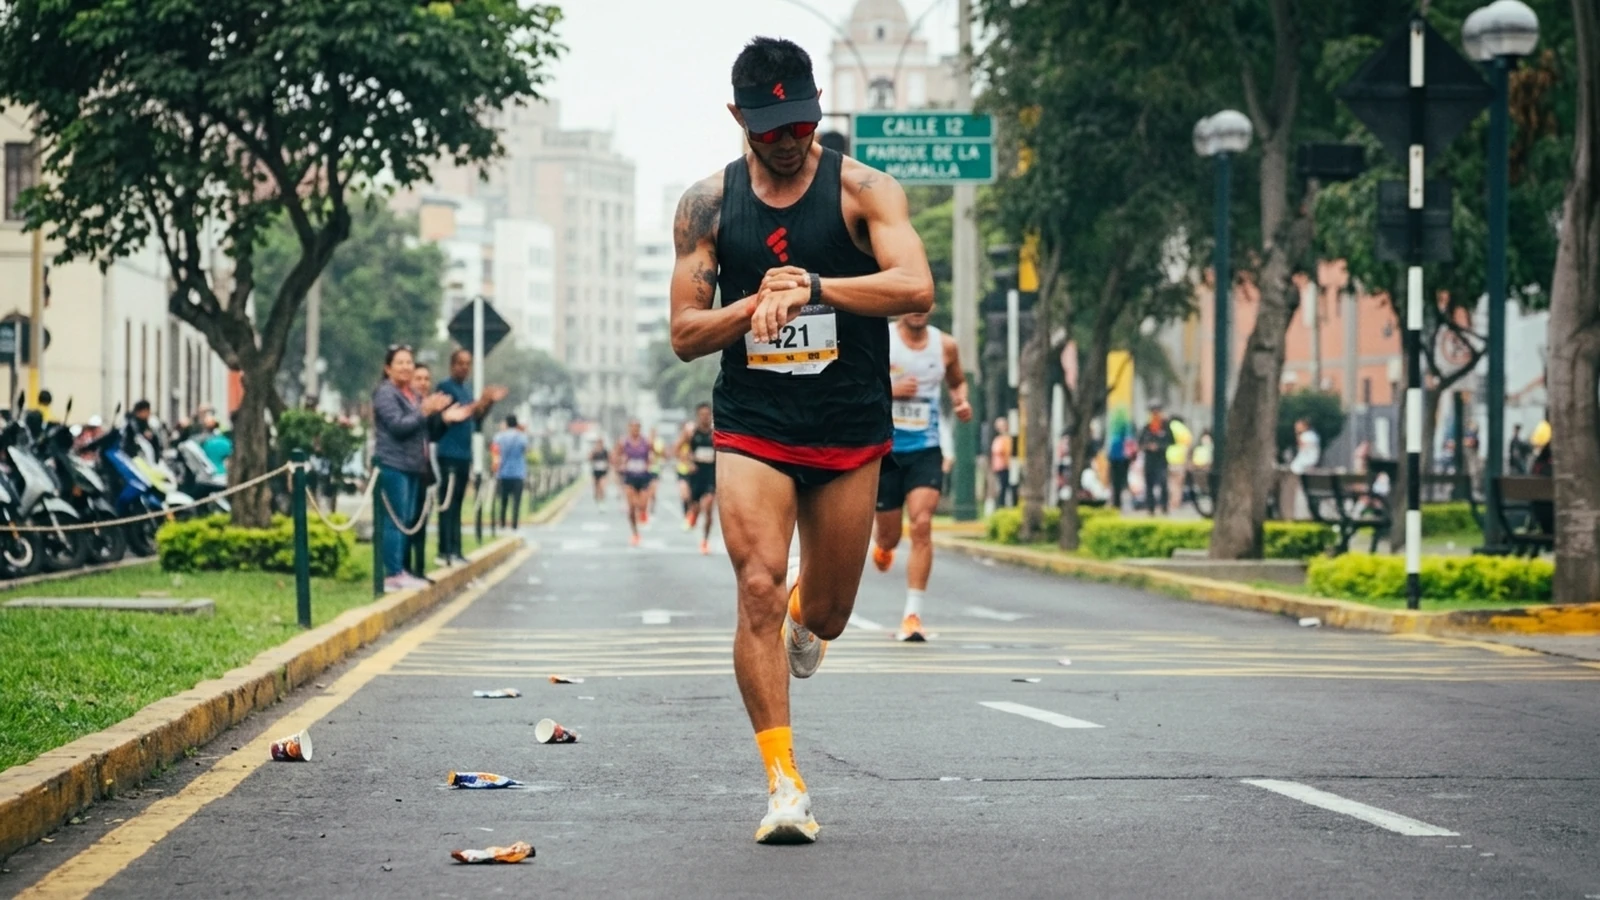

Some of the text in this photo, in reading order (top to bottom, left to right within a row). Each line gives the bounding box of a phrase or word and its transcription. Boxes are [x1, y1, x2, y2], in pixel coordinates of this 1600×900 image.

[882, 116, 965, 137] CALLE 12
[866, 144, 980, 161] PARQUE DE LA
